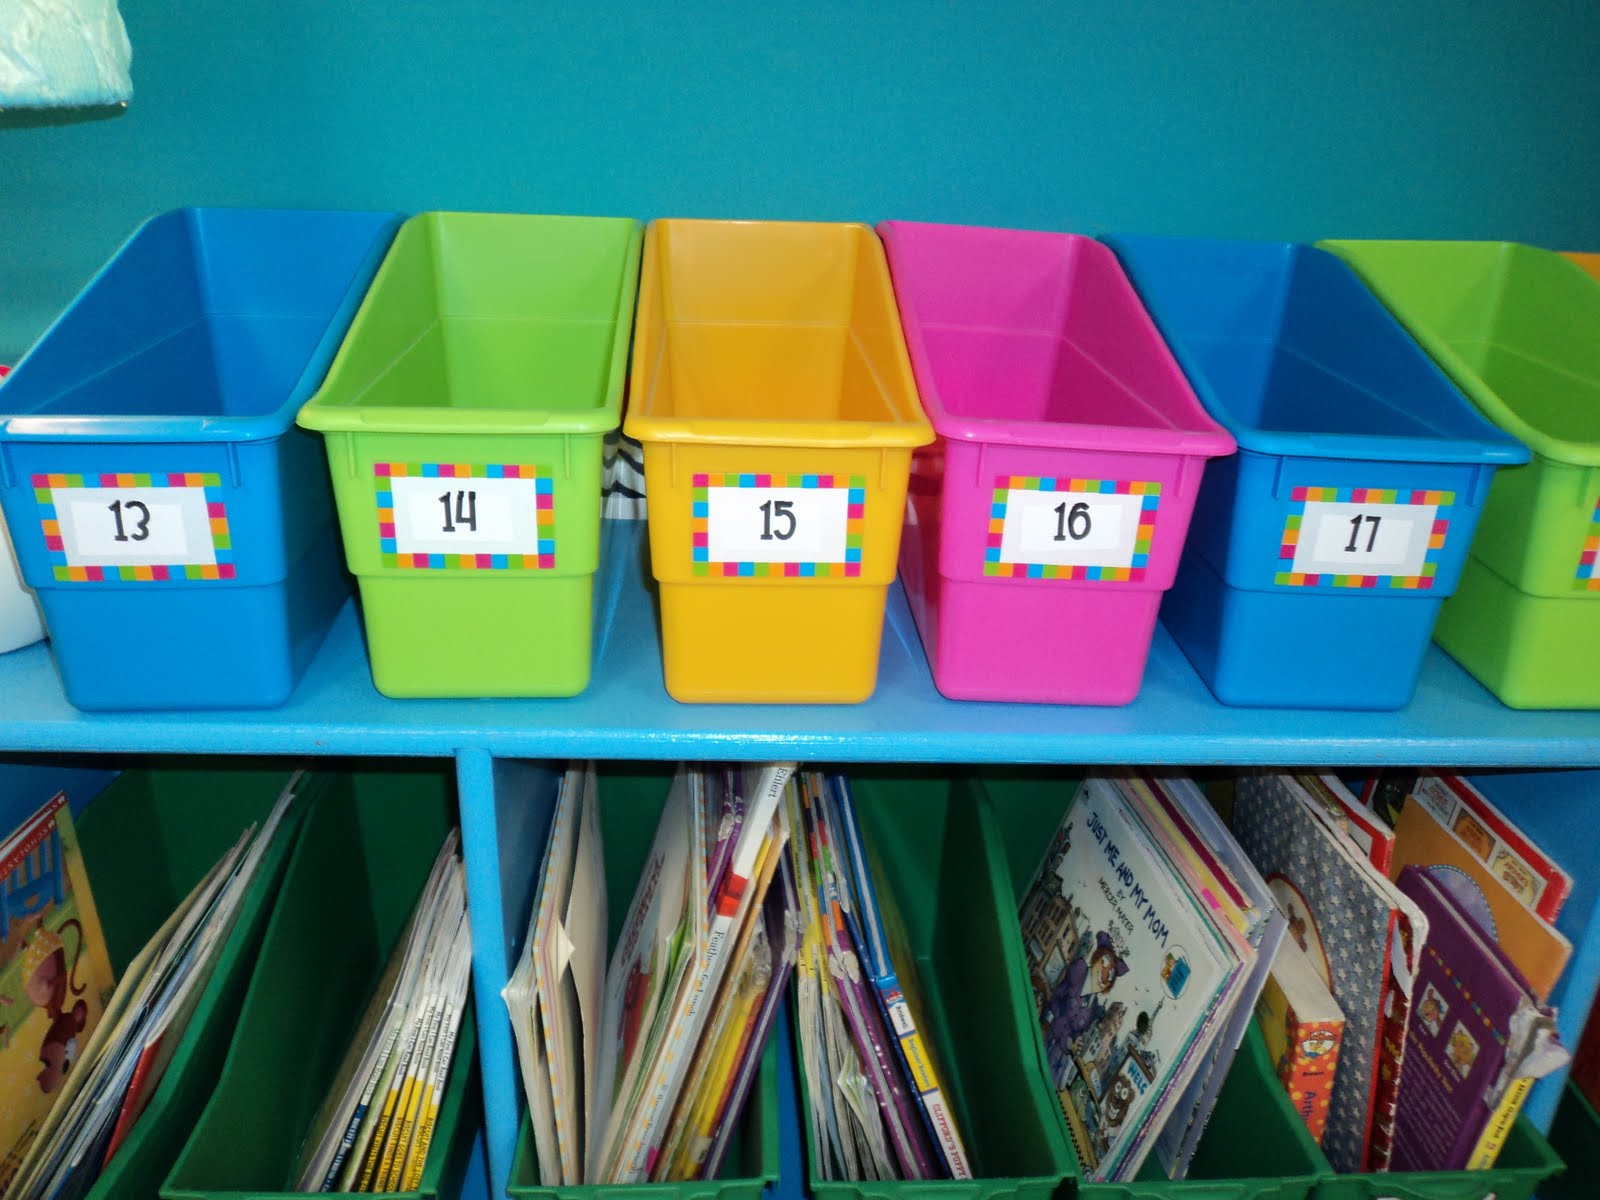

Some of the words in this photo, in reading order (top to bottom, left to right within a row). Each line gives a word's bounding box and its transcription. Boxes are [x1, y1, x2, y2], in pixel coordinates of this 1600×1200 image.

[108, 499, 150, 541] 13
[439, 490, 477, 532] 14
[759, 500, 796, 540] 15
[1054, 502, 1091, 541] 16
[1344, 514, 1381, 553] 17
[768, 767, 789, 799] Ehlert
[2, 828, 48, 876] SCHOLAST
[1086, 811, 1108, 845] JUST
[1103, 840, 1120, 867] ME
[1116, 862, 1134, 887] AND
[1130, 883, 1149, 910] MY
[1143, 905, 1169, 949] MOM
[1097, 877, 1117, 912] MERCER
[1116, 889, 1126, 901] BY
[932, 1103, 957, 1151] CLIFFORD'S
[951, 1151, 967, 1178] PUPPY
